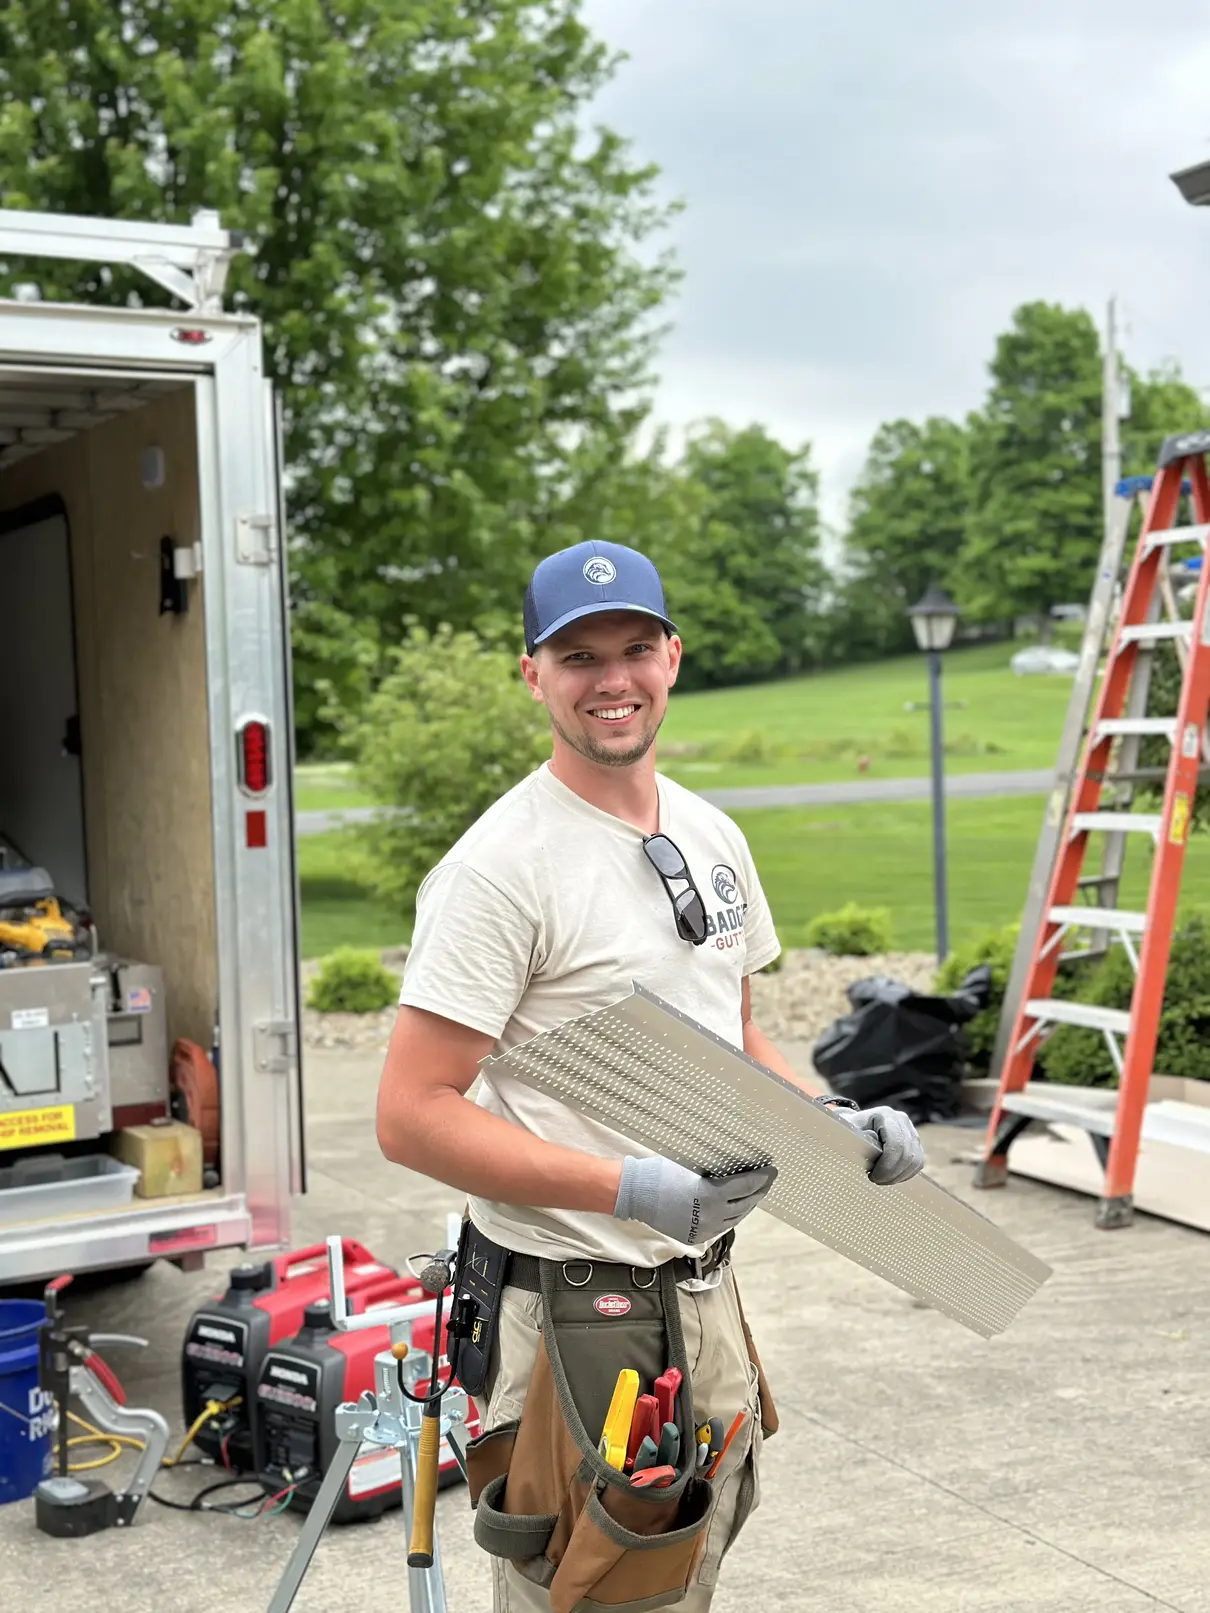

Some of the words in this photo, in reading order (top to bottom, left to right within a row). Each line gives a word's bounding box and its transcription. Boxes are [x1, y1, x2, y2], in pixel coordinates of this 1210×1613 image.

[692, 1198, 701, 1225] GRIP
[687, 1225, 699, 1244] FIRM
[197, 1324, 236, 1343] HONDA
[269, 1365, 309, 1386] HONDA
